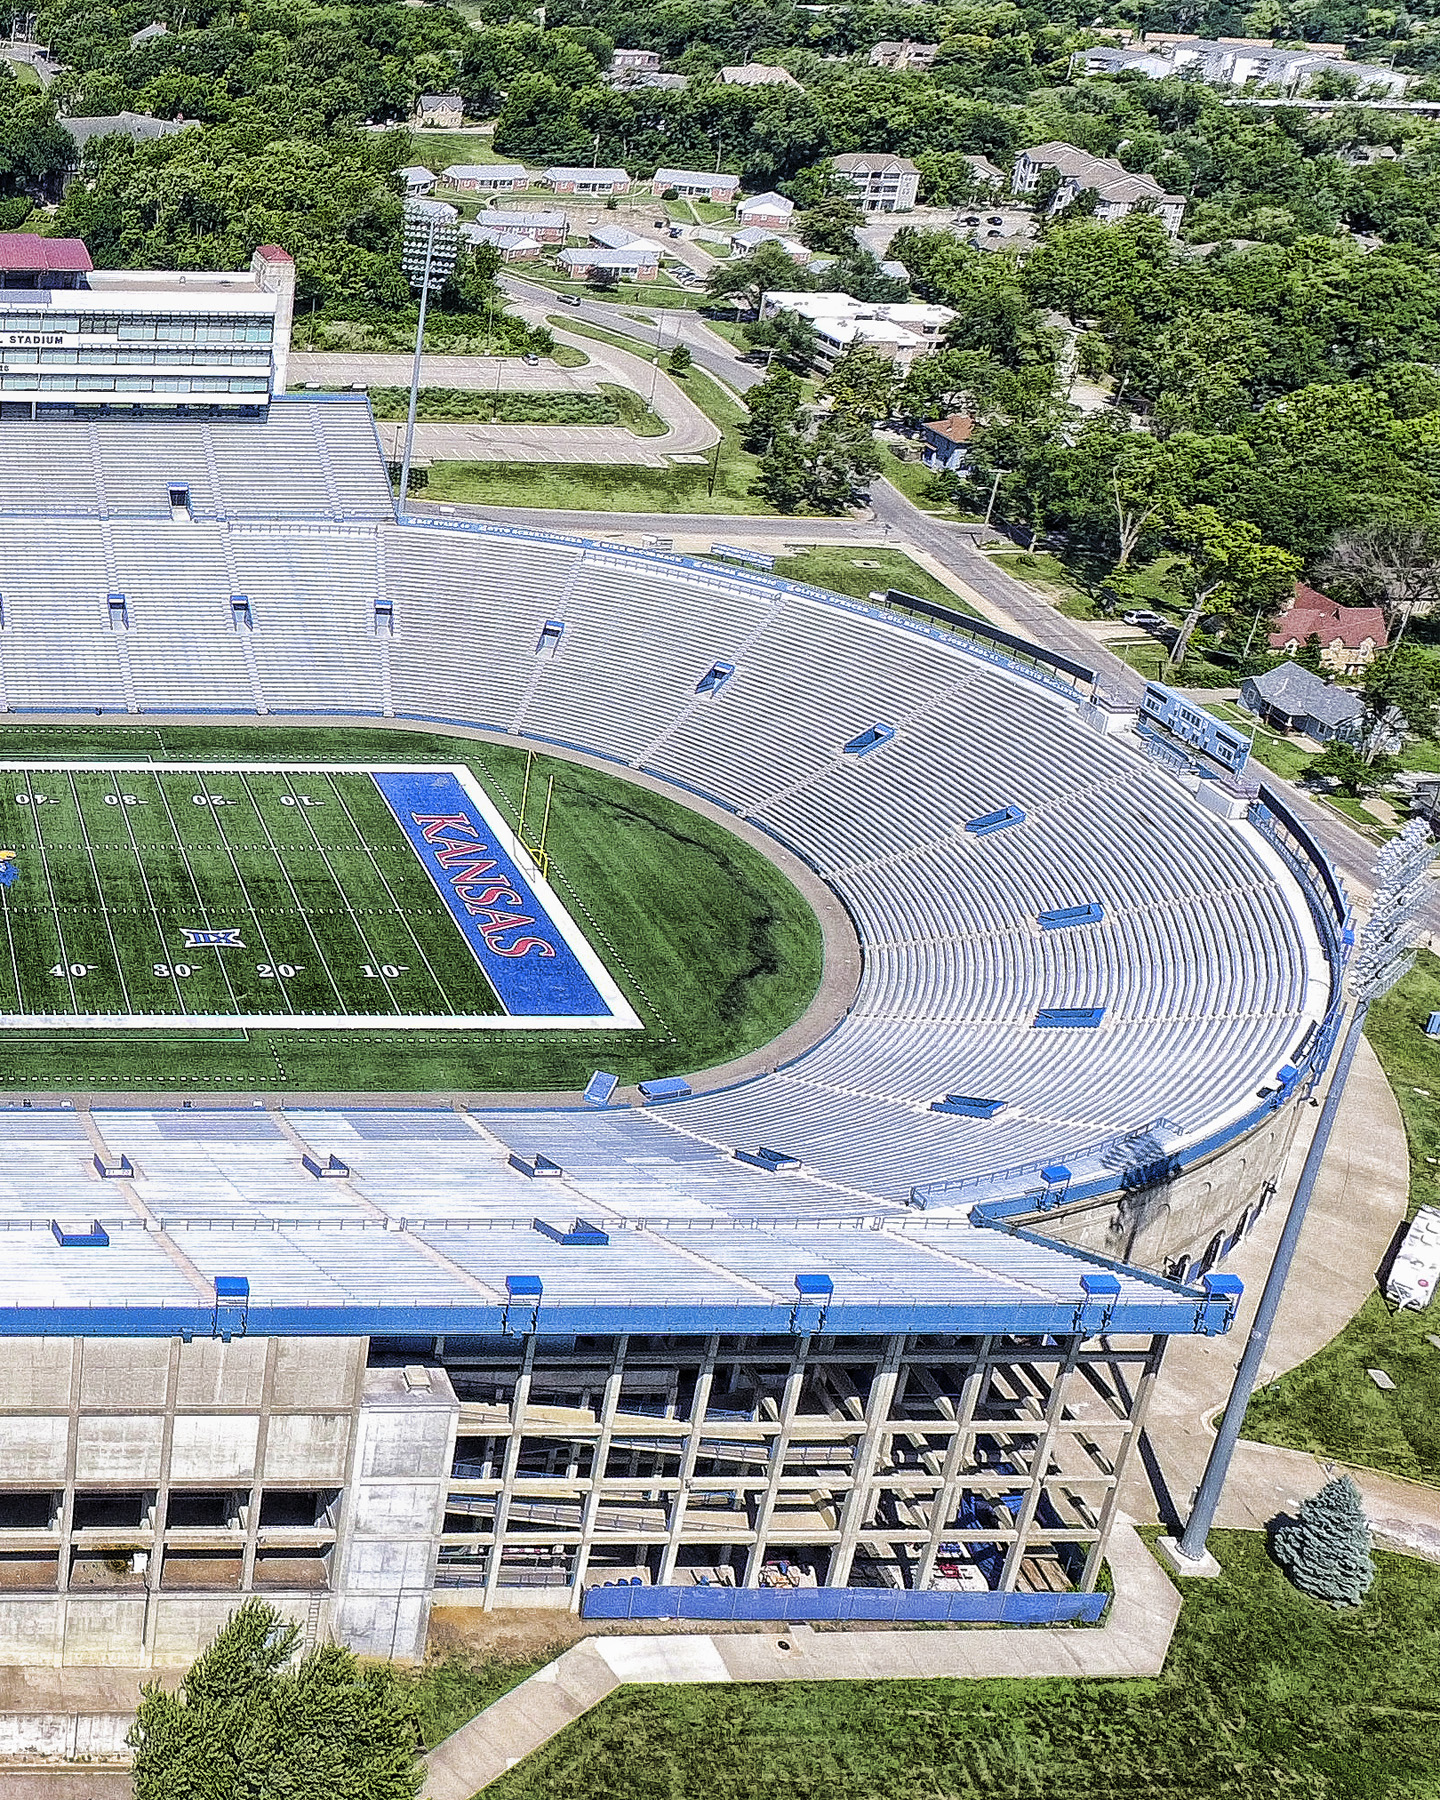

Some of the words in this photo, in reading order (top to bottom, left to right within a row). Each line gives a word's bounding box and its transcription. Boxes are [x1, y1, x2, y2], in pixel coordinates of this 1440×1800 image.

[9, 335, 63, 344] STADIUM
[15, 794, 48, 805] 40
[104, 794, 139, 805] 30
[192, 795, 228, 806] 20
[280, 795, 315, 806] 10
[411, 812, 556, 958] KANSAS
[49, 963, 89, 977] 40
[153, 963, 191, 977] 30
[257, 963, 296, 978] 20
[361, 965, 401, 978] 10
